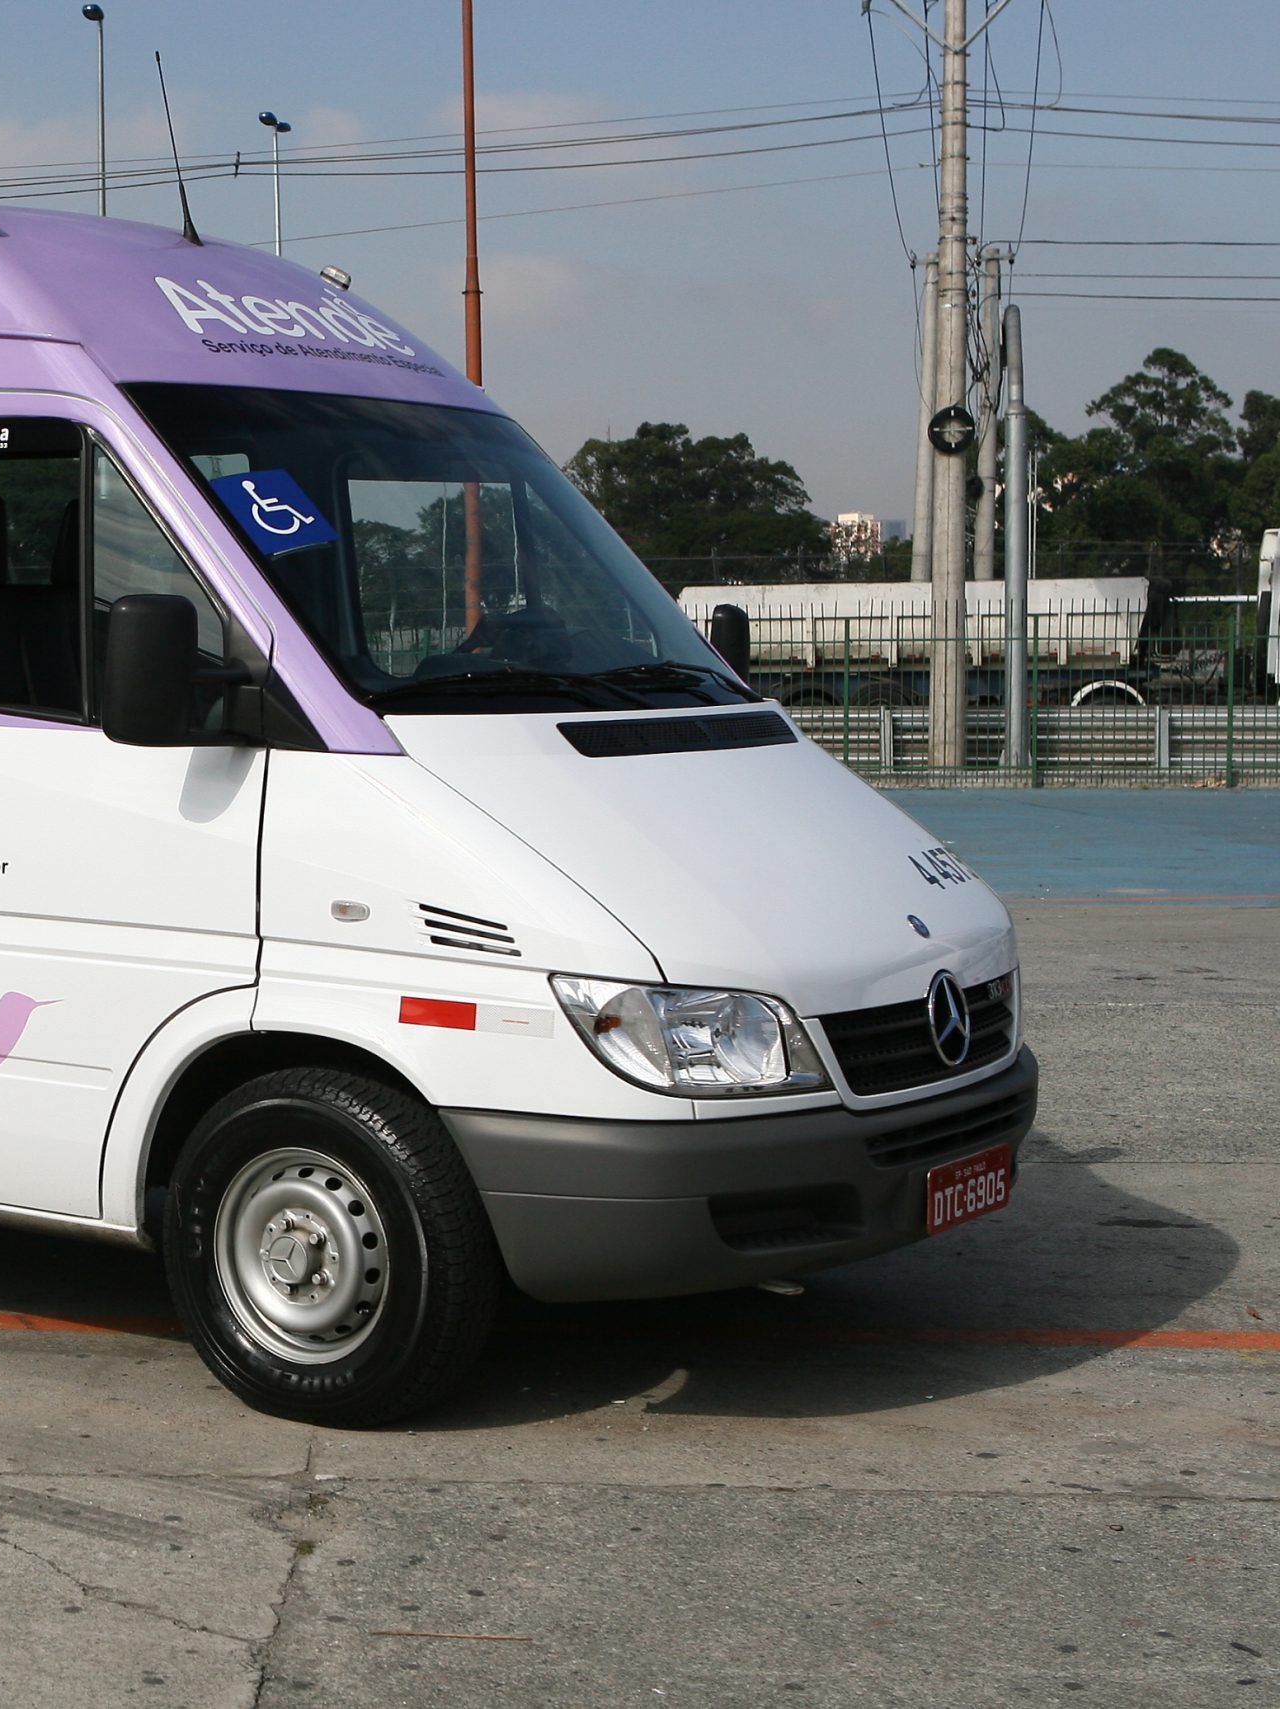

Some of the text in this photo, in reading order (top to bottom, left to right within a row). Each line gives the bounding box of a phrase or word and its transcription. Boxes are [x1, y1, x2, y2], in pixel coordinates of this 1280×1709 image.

[201, 339, 274, 357] Serviço
[275, 342, 299, 356] de
[297, 343, 392, 366] Atendimento
[908, 855, 946, 890] 4
